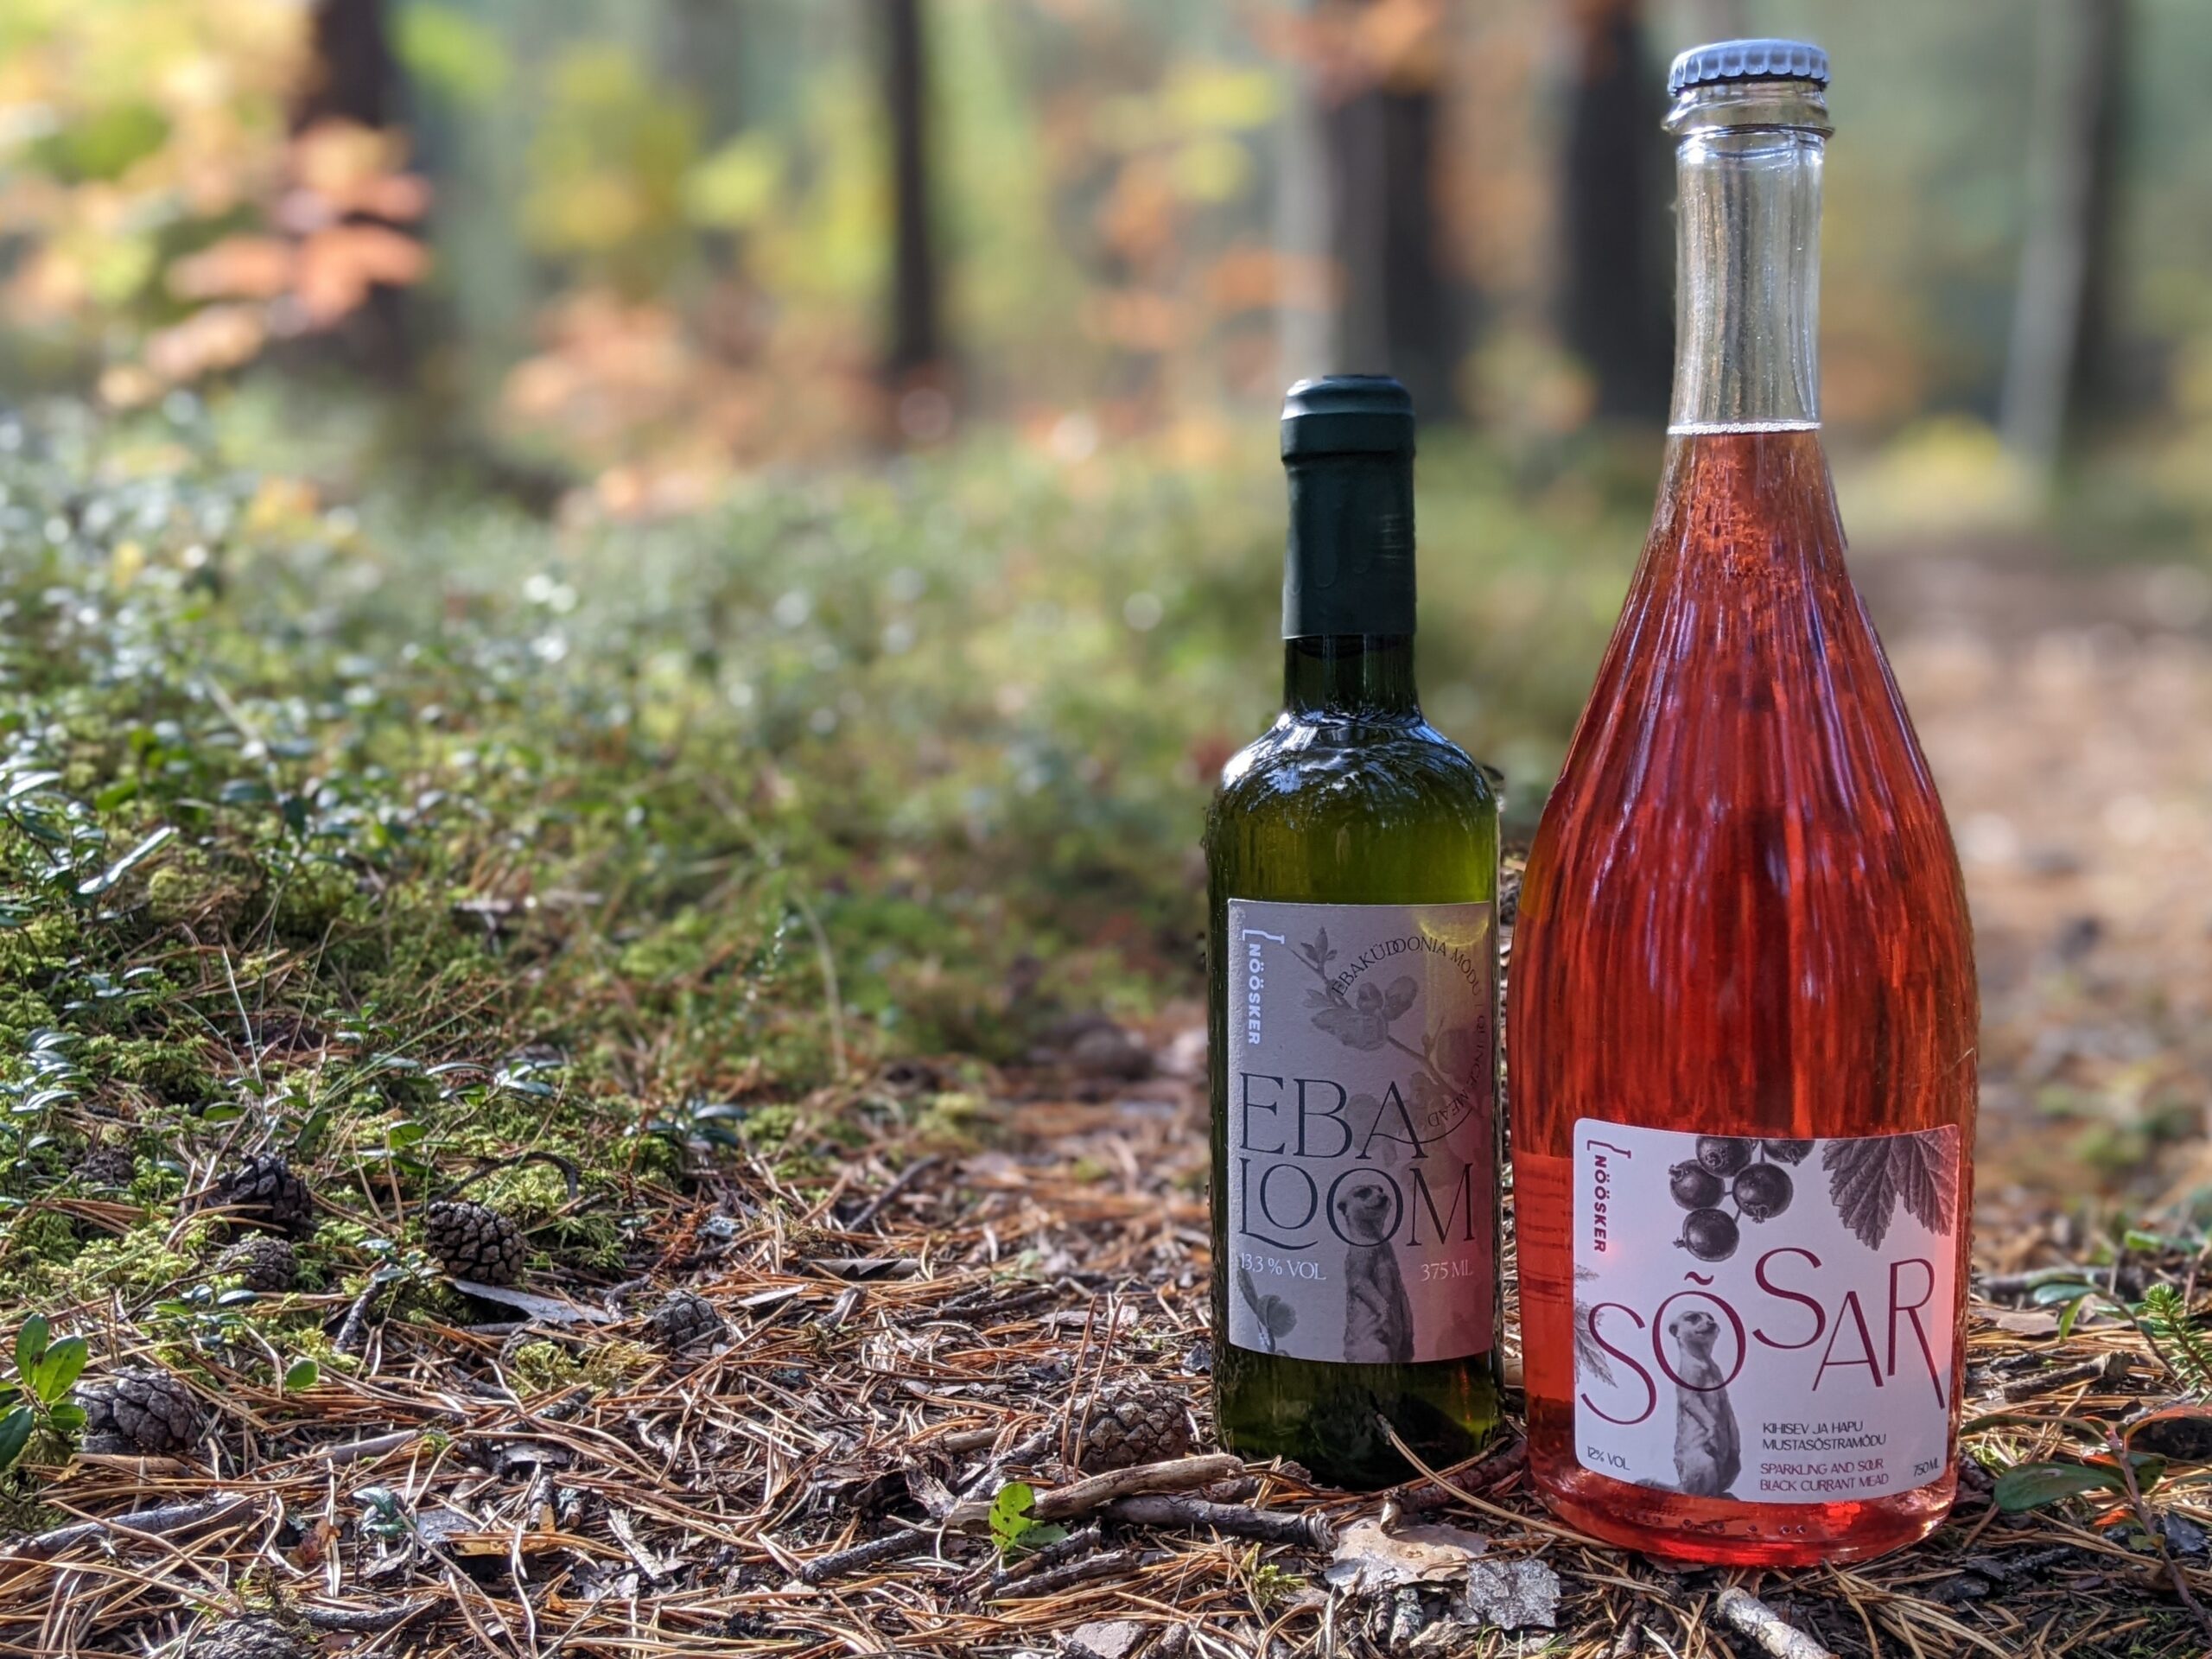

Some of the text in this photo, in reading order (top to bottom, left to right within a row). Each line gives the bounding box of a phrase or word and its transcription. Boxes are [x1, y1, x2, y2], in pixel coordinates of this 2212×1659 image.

[1248, 944, 1264, 1045] NÖÖSKER
[1239, 1072, 1429, 1160] EBA
[1427, 1091, 1471, 1128] MEAD
[1239, 1158, 1475, 1250] LOOM
[1593, 1154, 1610, 1253] NÖÖSKER
[1268, 1257, 1283, 1275] %
[1287, 1260, 1326, 1281] VOL
[1421, 1259, 1473, 1281] 375 ML
[1580, 1247, 1947, 1425] SÕSAR
[1763, 1421, 1864, 1434] KIHISEV JA HAPU
[1607, 1452, 1630, 1471] VOL
[1760, 1459, 1884, 1476] SPARKLING AND SOUR
[1760, 1473, 1890, 1493] BLACK CURRANT MEAD
